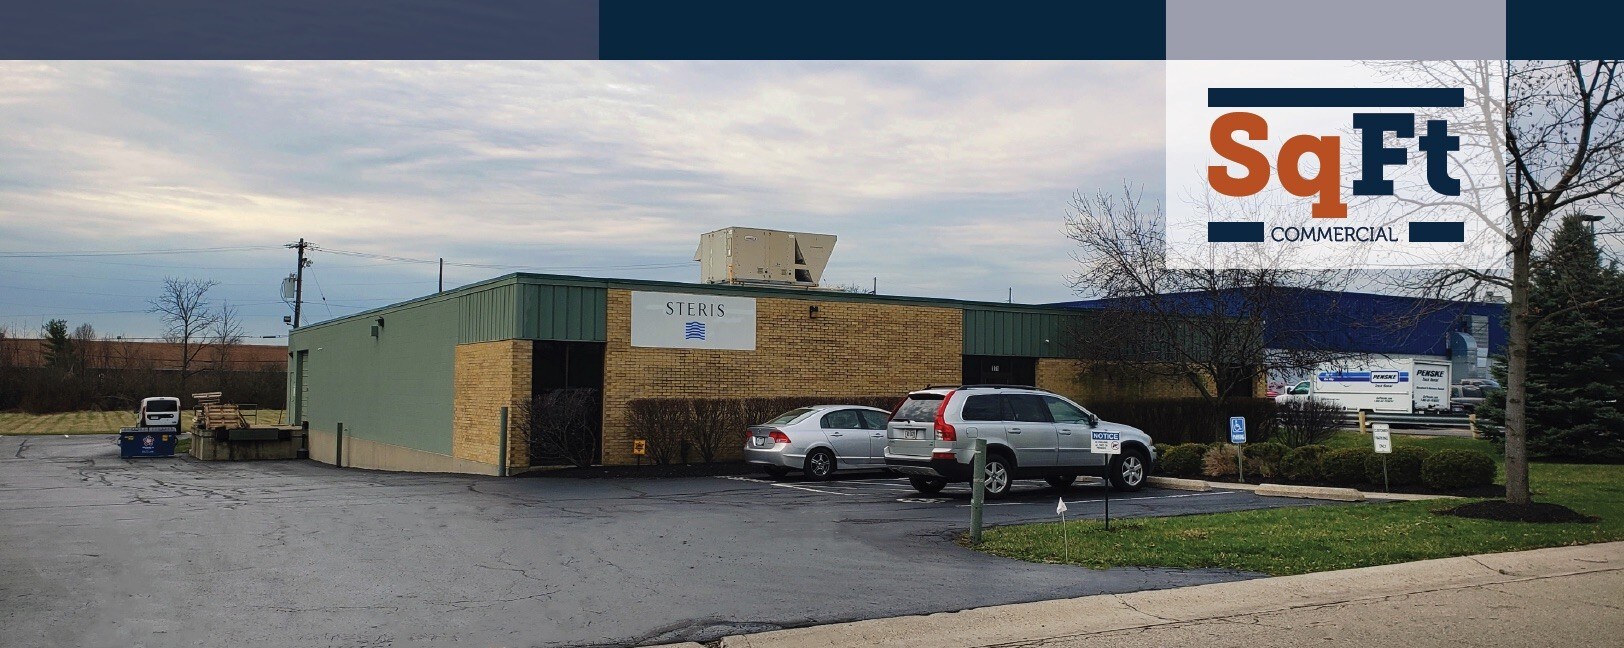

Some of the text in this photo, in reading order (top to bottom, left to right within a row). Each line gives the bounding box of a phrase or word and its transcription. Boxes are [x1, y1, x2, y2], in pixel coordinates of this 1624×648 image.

[665, 301, 725, 317] STERIS
[1416, 369, 1445, 378] PENSKE
[1093, 432, 1119, 440] NOTICE
